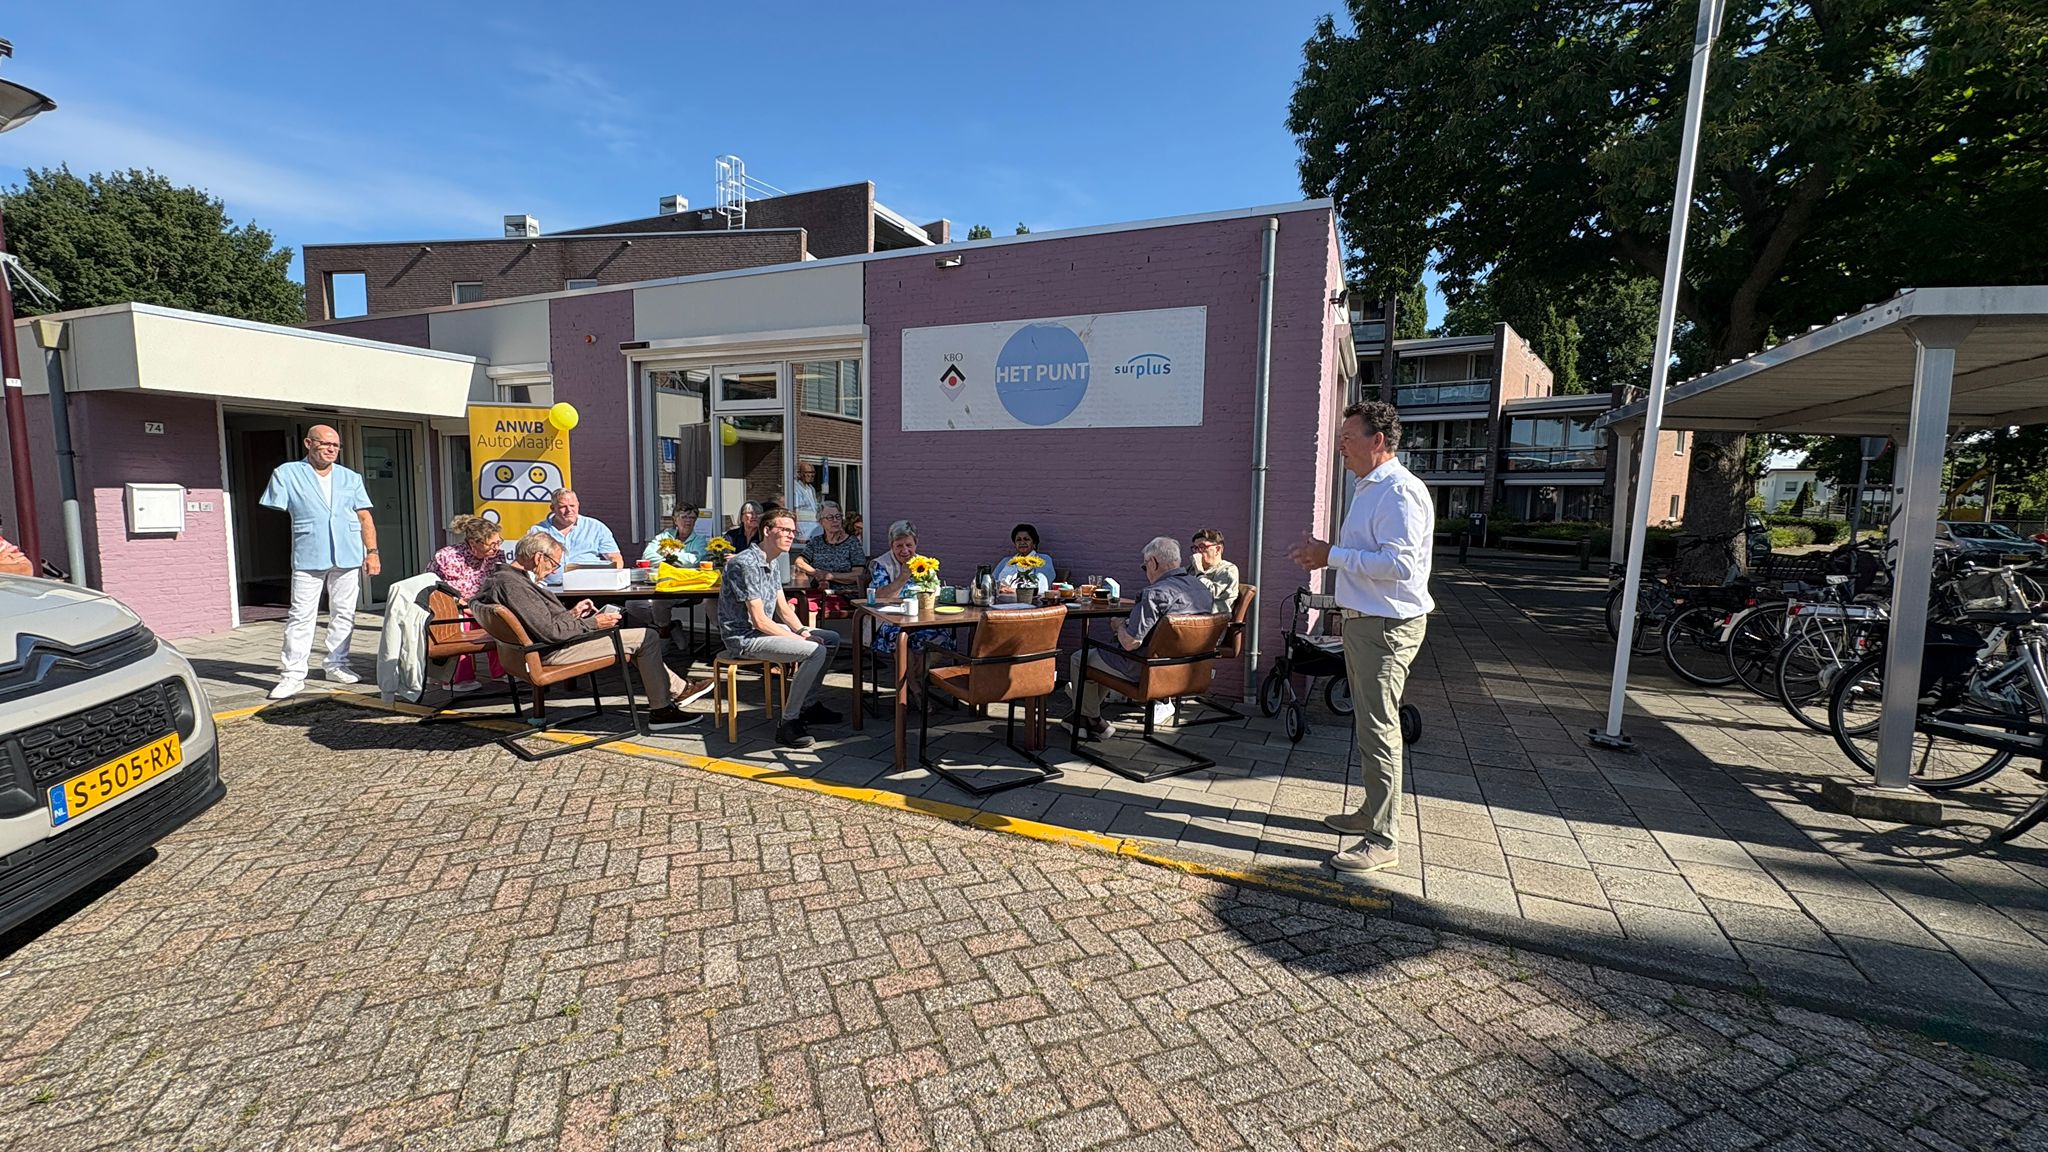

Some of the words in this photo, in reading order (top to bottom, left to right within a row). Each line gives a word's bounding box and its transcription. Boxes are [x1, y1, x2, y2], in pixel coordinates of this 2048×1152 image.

[943, 353, 963, 362] KBO
[996, 364, 1032, 384] HET
[1036, 361, 1090, 382] PUNT
[1114, 357, 1171, 379] surplus
[147, 424, 161, 432] 74
[495, 420, 544, 434] ANWB
[477, 434, 564, 451] AutoMaatje
[73, 739, 174, 808] S-505-RX
[54, 808, 66, 817] NL
